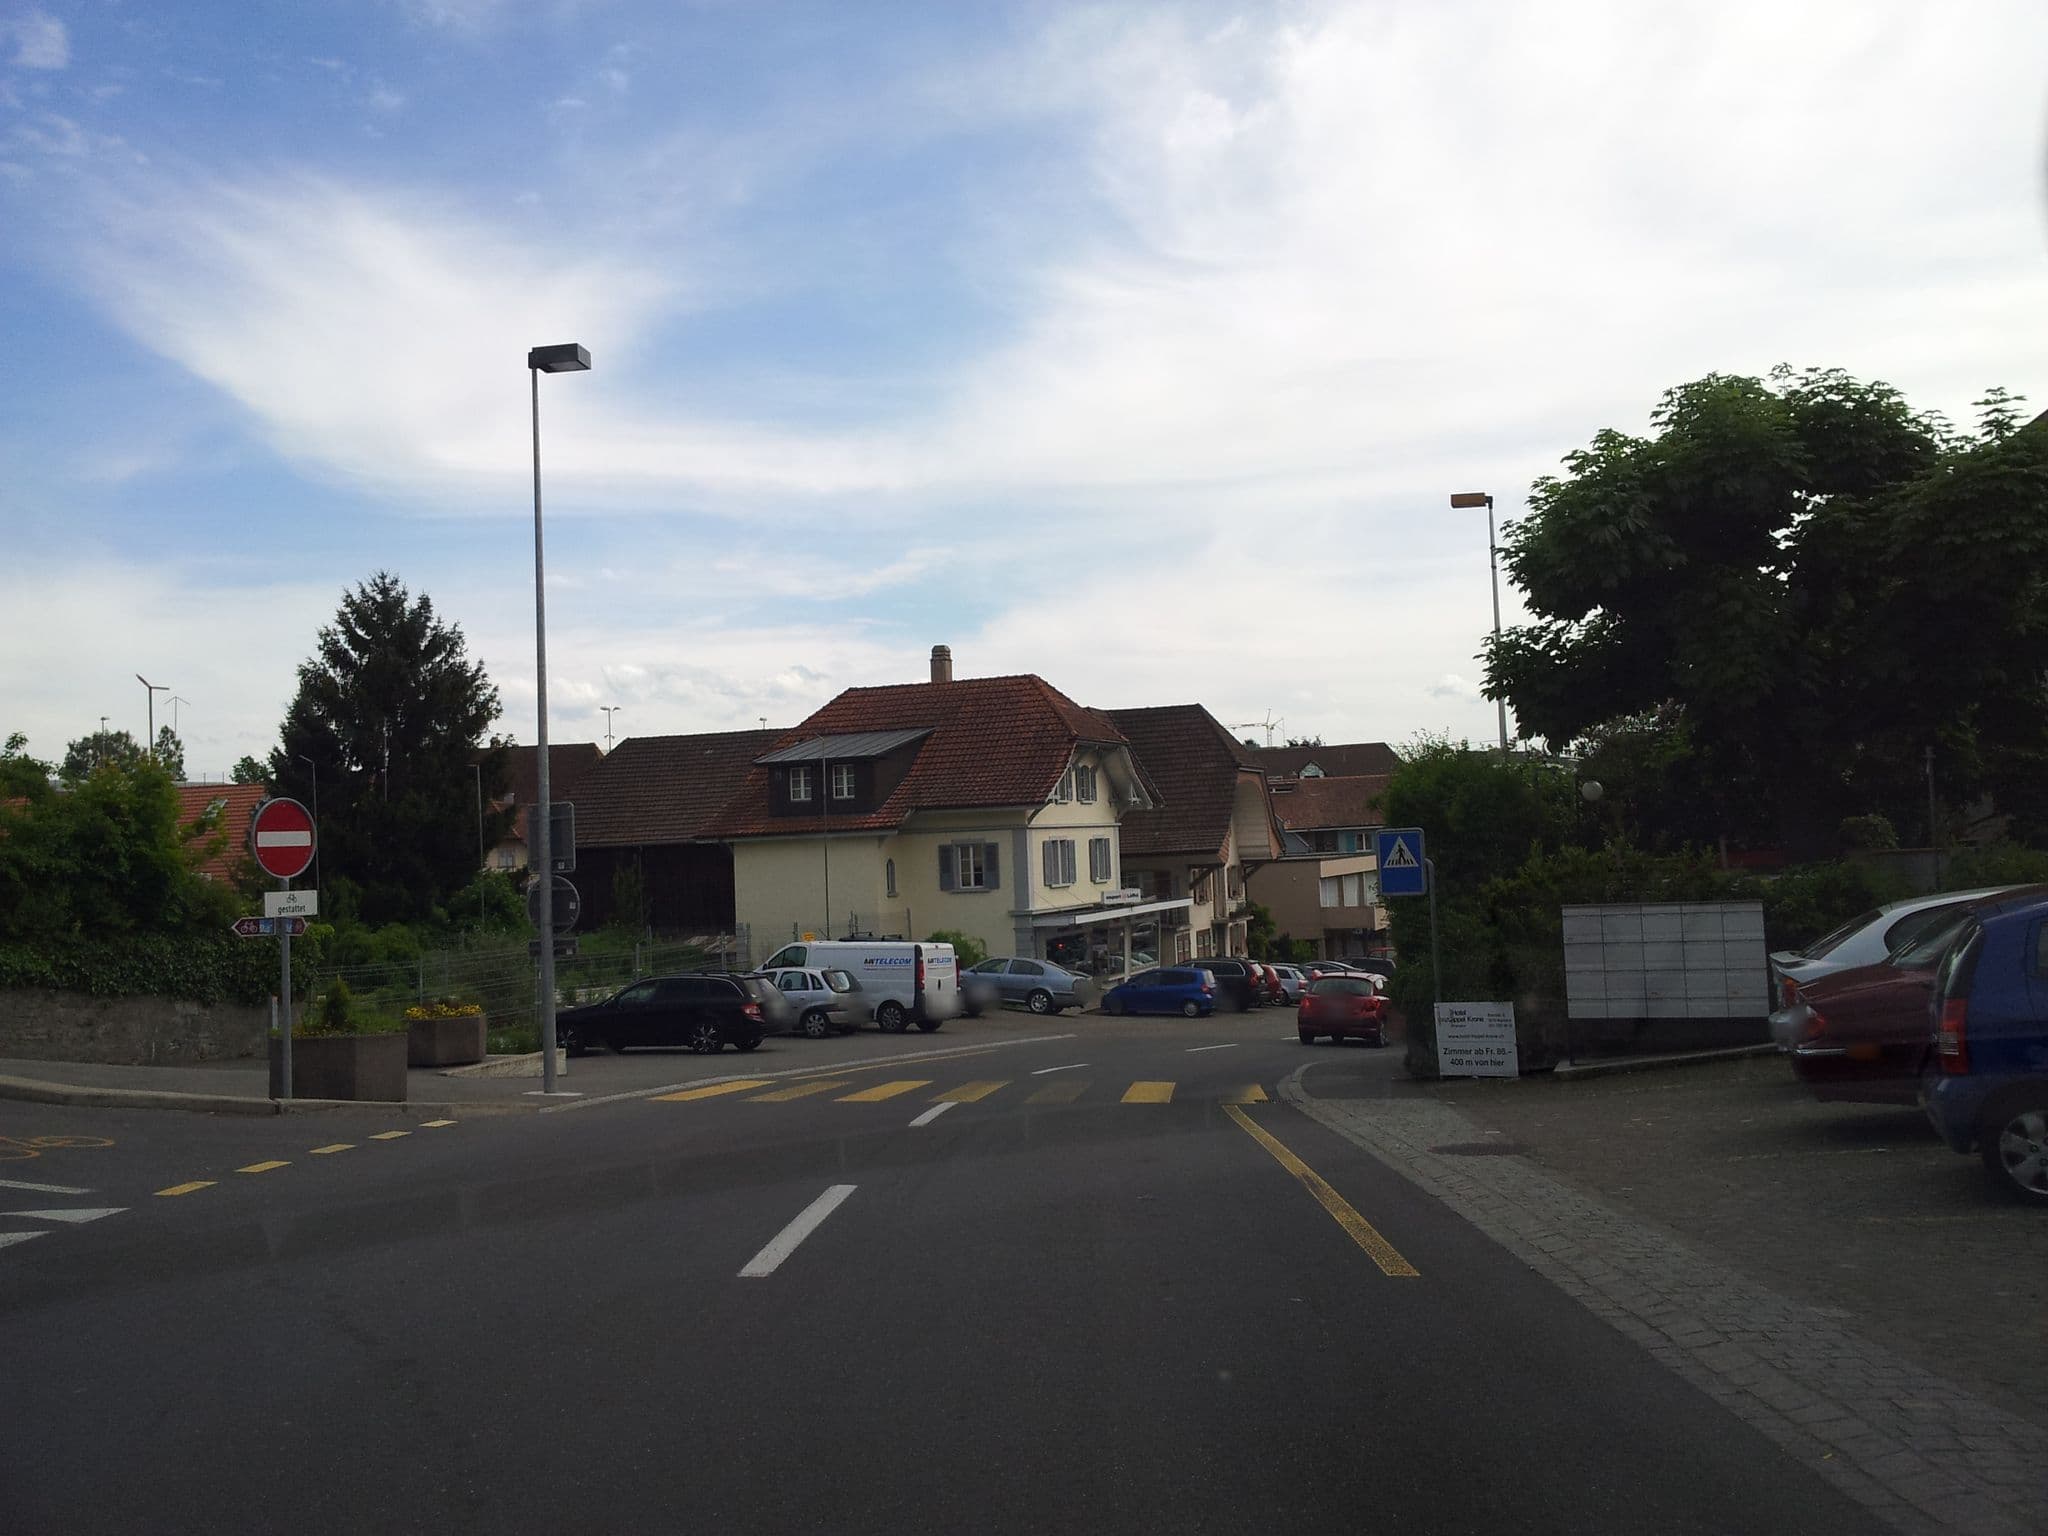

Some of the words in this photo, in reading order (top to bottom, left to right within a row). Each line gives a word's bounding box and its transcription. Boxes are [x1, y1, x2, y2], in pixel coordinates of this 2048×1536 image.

[278, 905, 306, 915] gestattet
[1443, 1047, 1472, 1055] Zimmer
[1474, 1047, 1484, 1055] ab
[1490, 1059, 1505, 1067] hier
